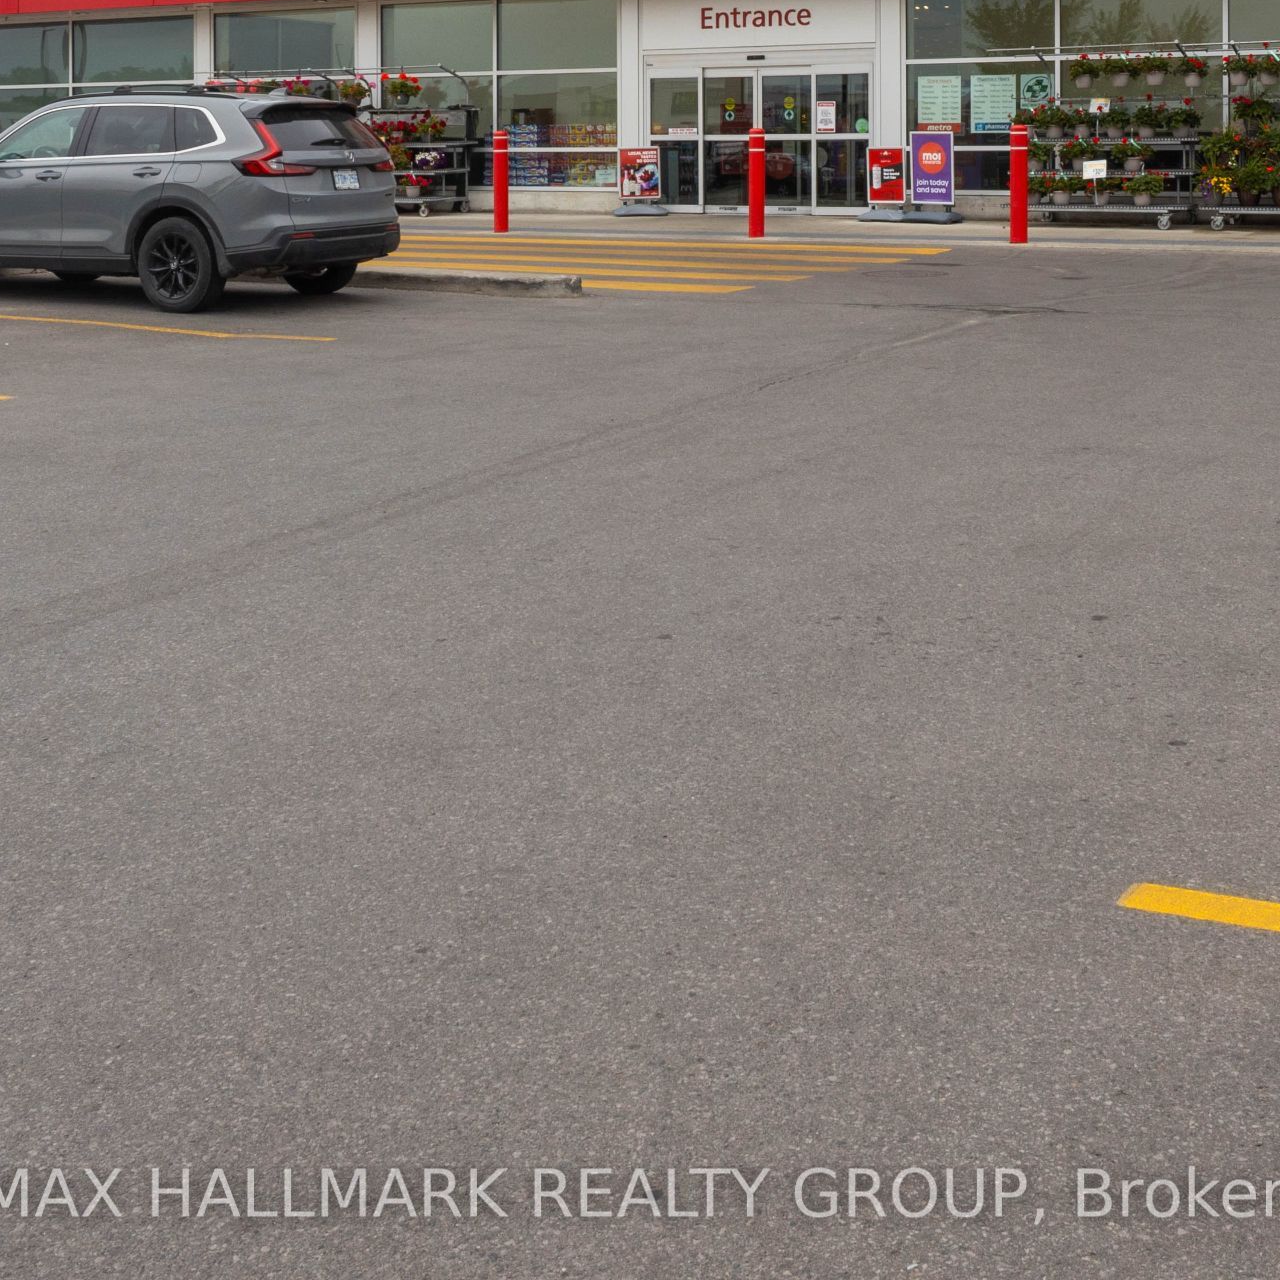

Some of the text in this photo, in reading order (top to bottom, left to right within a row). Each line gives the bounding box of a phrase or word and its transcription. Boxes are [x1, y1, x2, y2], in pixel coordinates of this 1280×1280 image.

[700, 7, 811, 30] Entrance
[916, 178, 949, 187] join today
